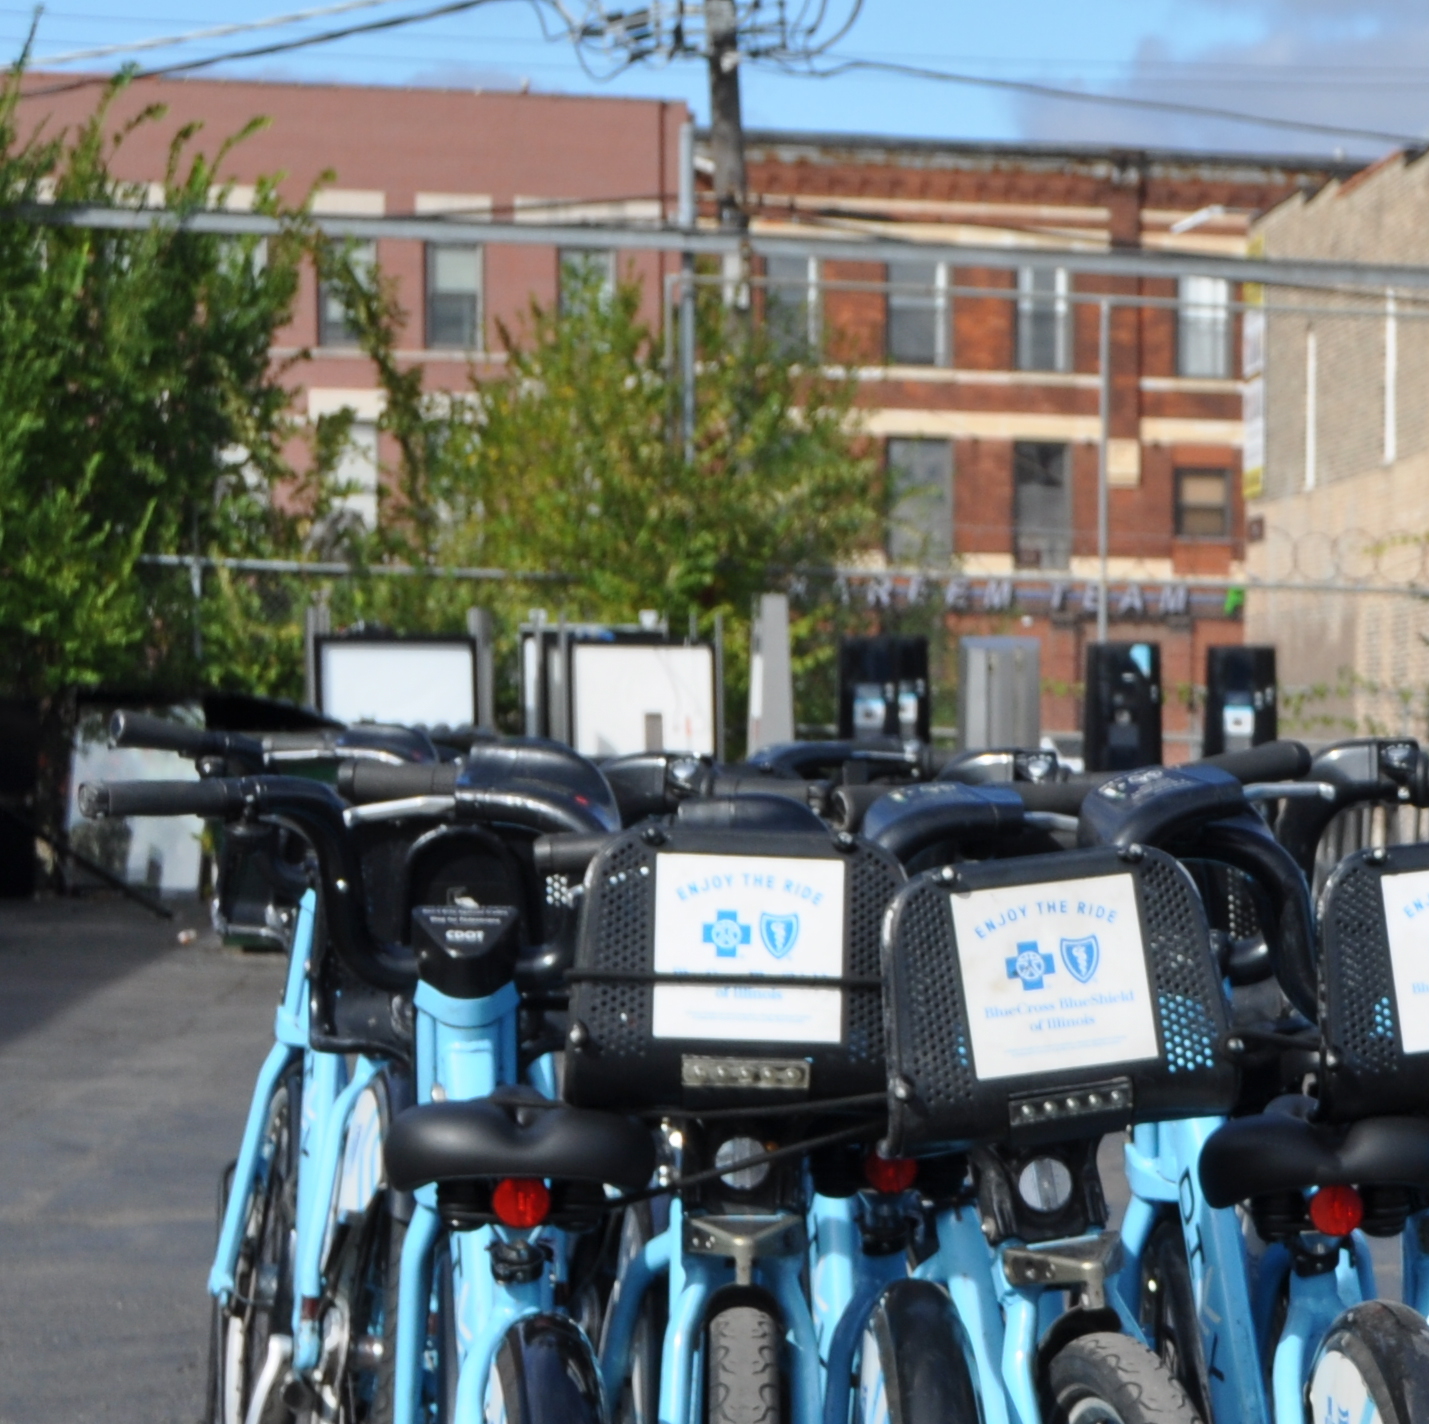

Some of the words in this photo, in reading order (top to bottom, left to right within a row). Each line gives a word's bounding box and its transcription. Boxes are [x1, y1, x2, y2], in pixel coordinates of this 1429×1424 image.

[676, 875, 734, 901] ENJOY
[743, 873, 775, 888] THE
[783, 879, 824, 906] RIDE
[974, 904, 1029, 939] ENJOY
[1035, 900, 1068, 915] THE
[1077, 901, 1118, 924] RIDE
